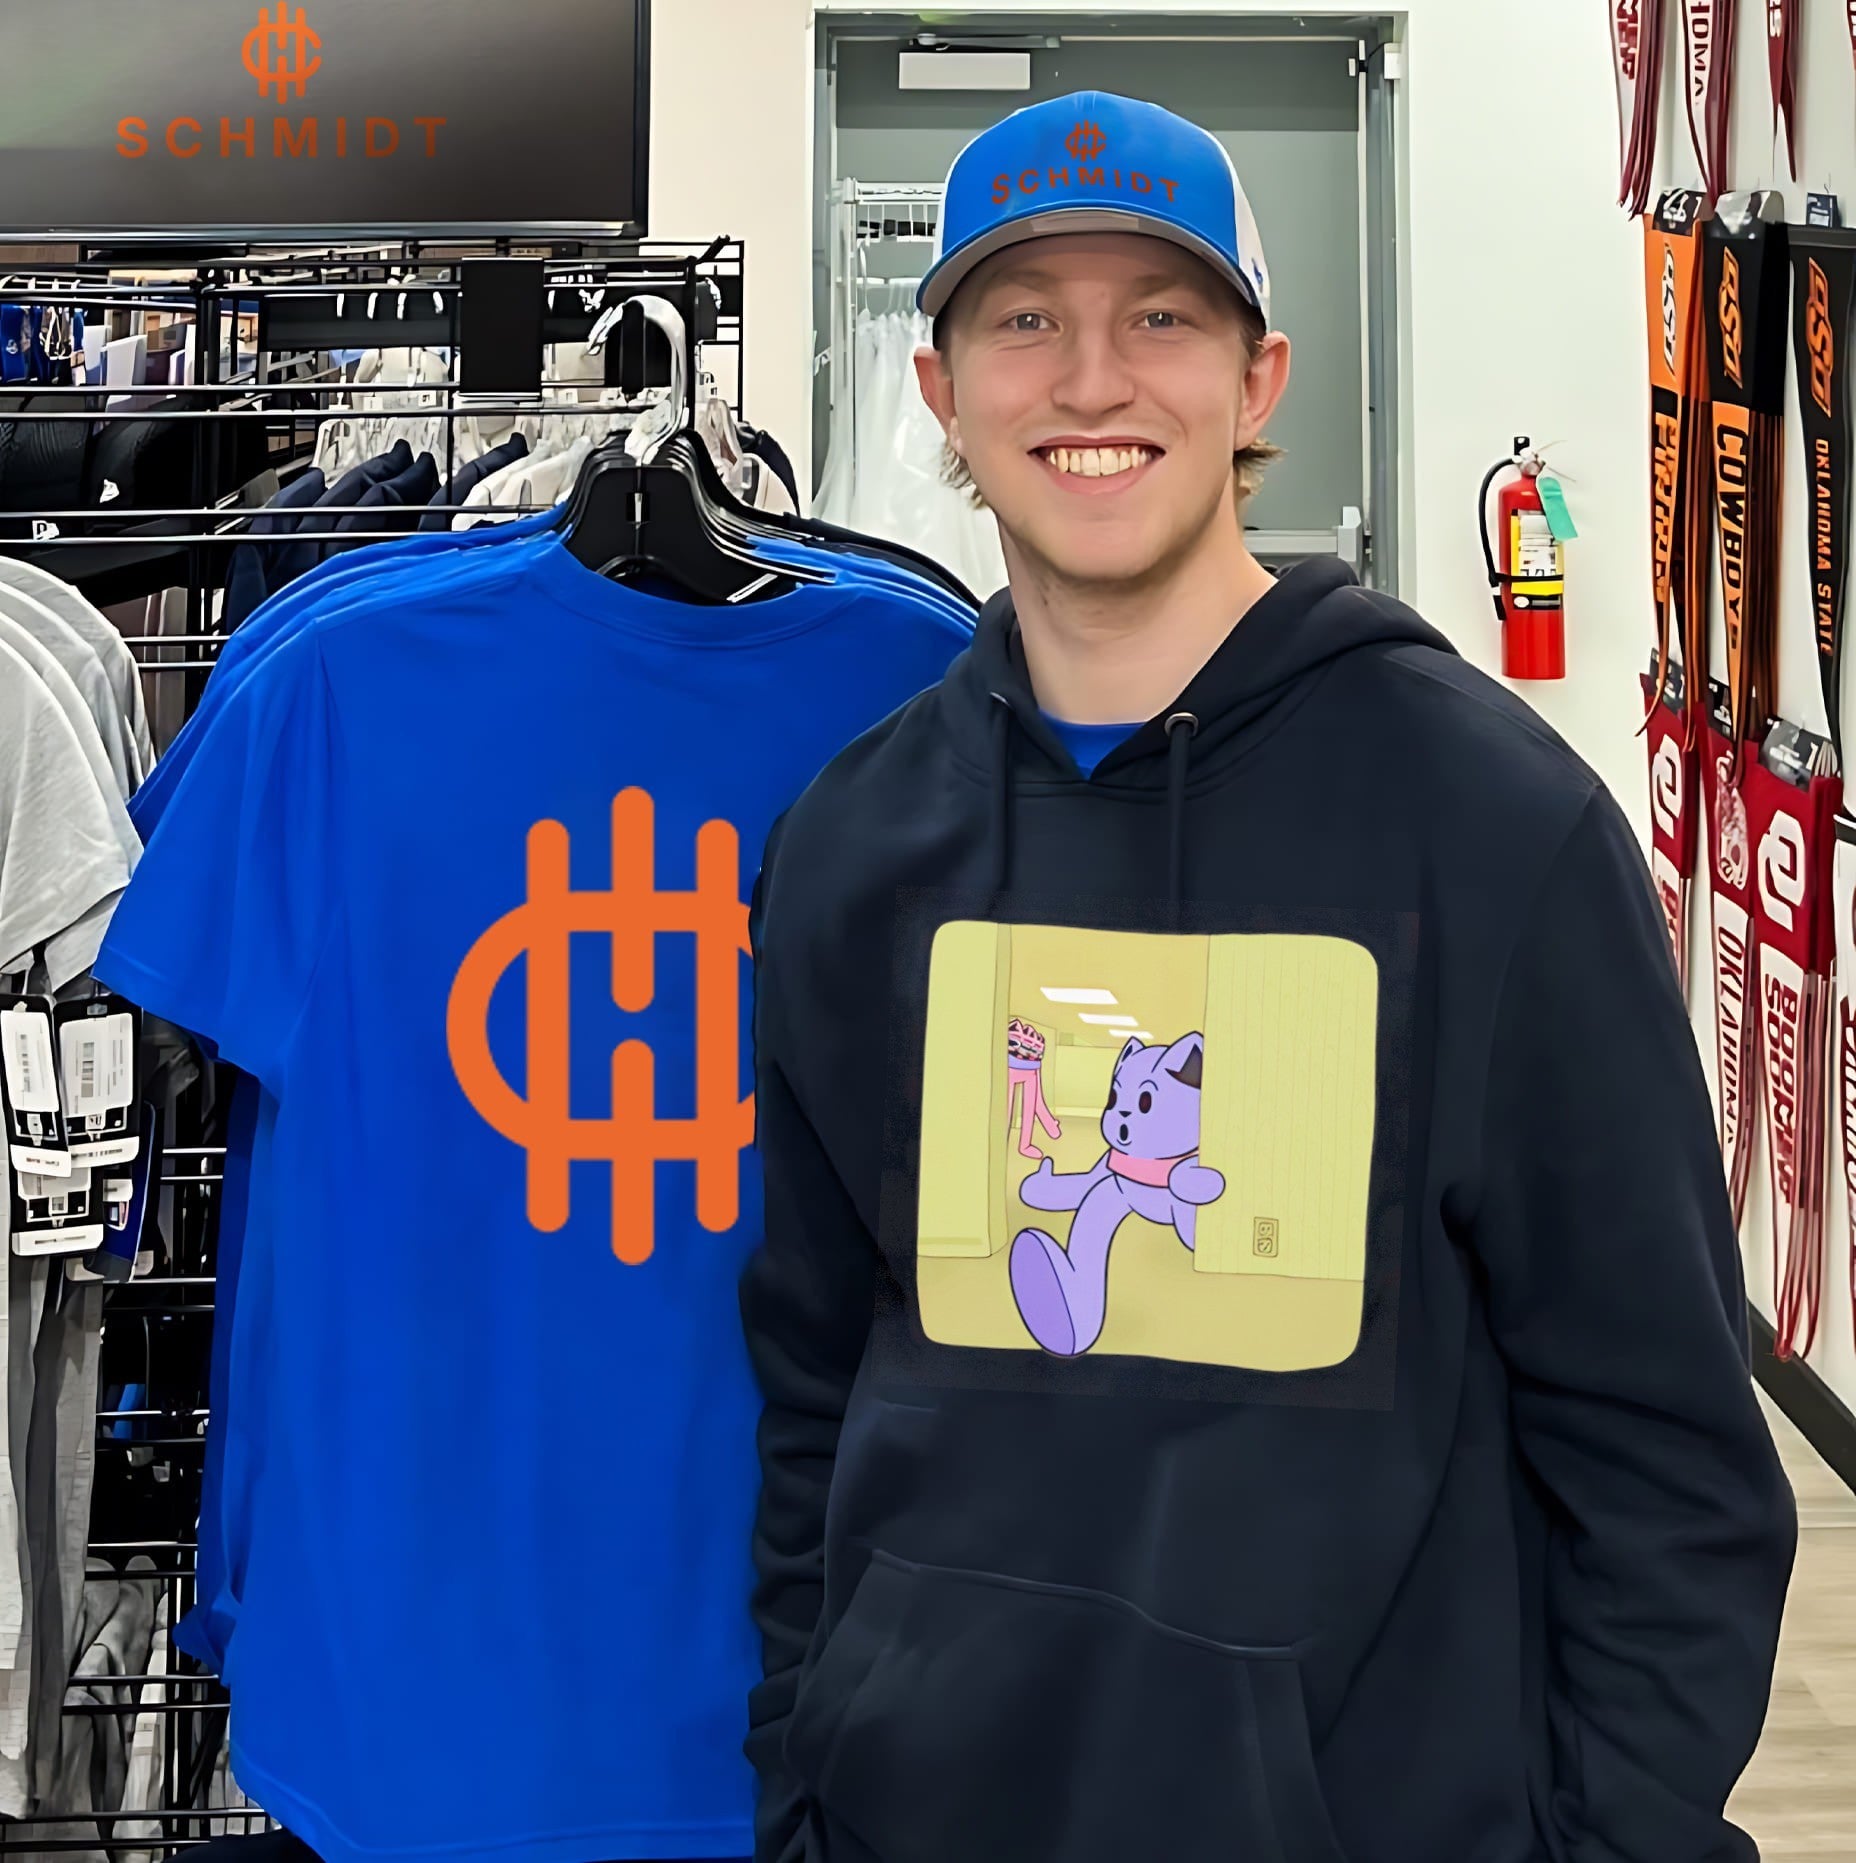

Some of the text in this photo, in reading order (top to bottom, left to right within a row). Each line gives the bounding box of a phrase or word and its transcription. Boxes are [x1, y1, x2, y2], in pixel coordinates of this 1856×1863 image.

[115, 116, 447, 159] SCHMIDT
[991, 166, 1179, 205] SCHMIDT
[1815, 438, 1832, 571] OKLAHOMA
[1717, 926, 1746, 1144] OKLAHOMA
